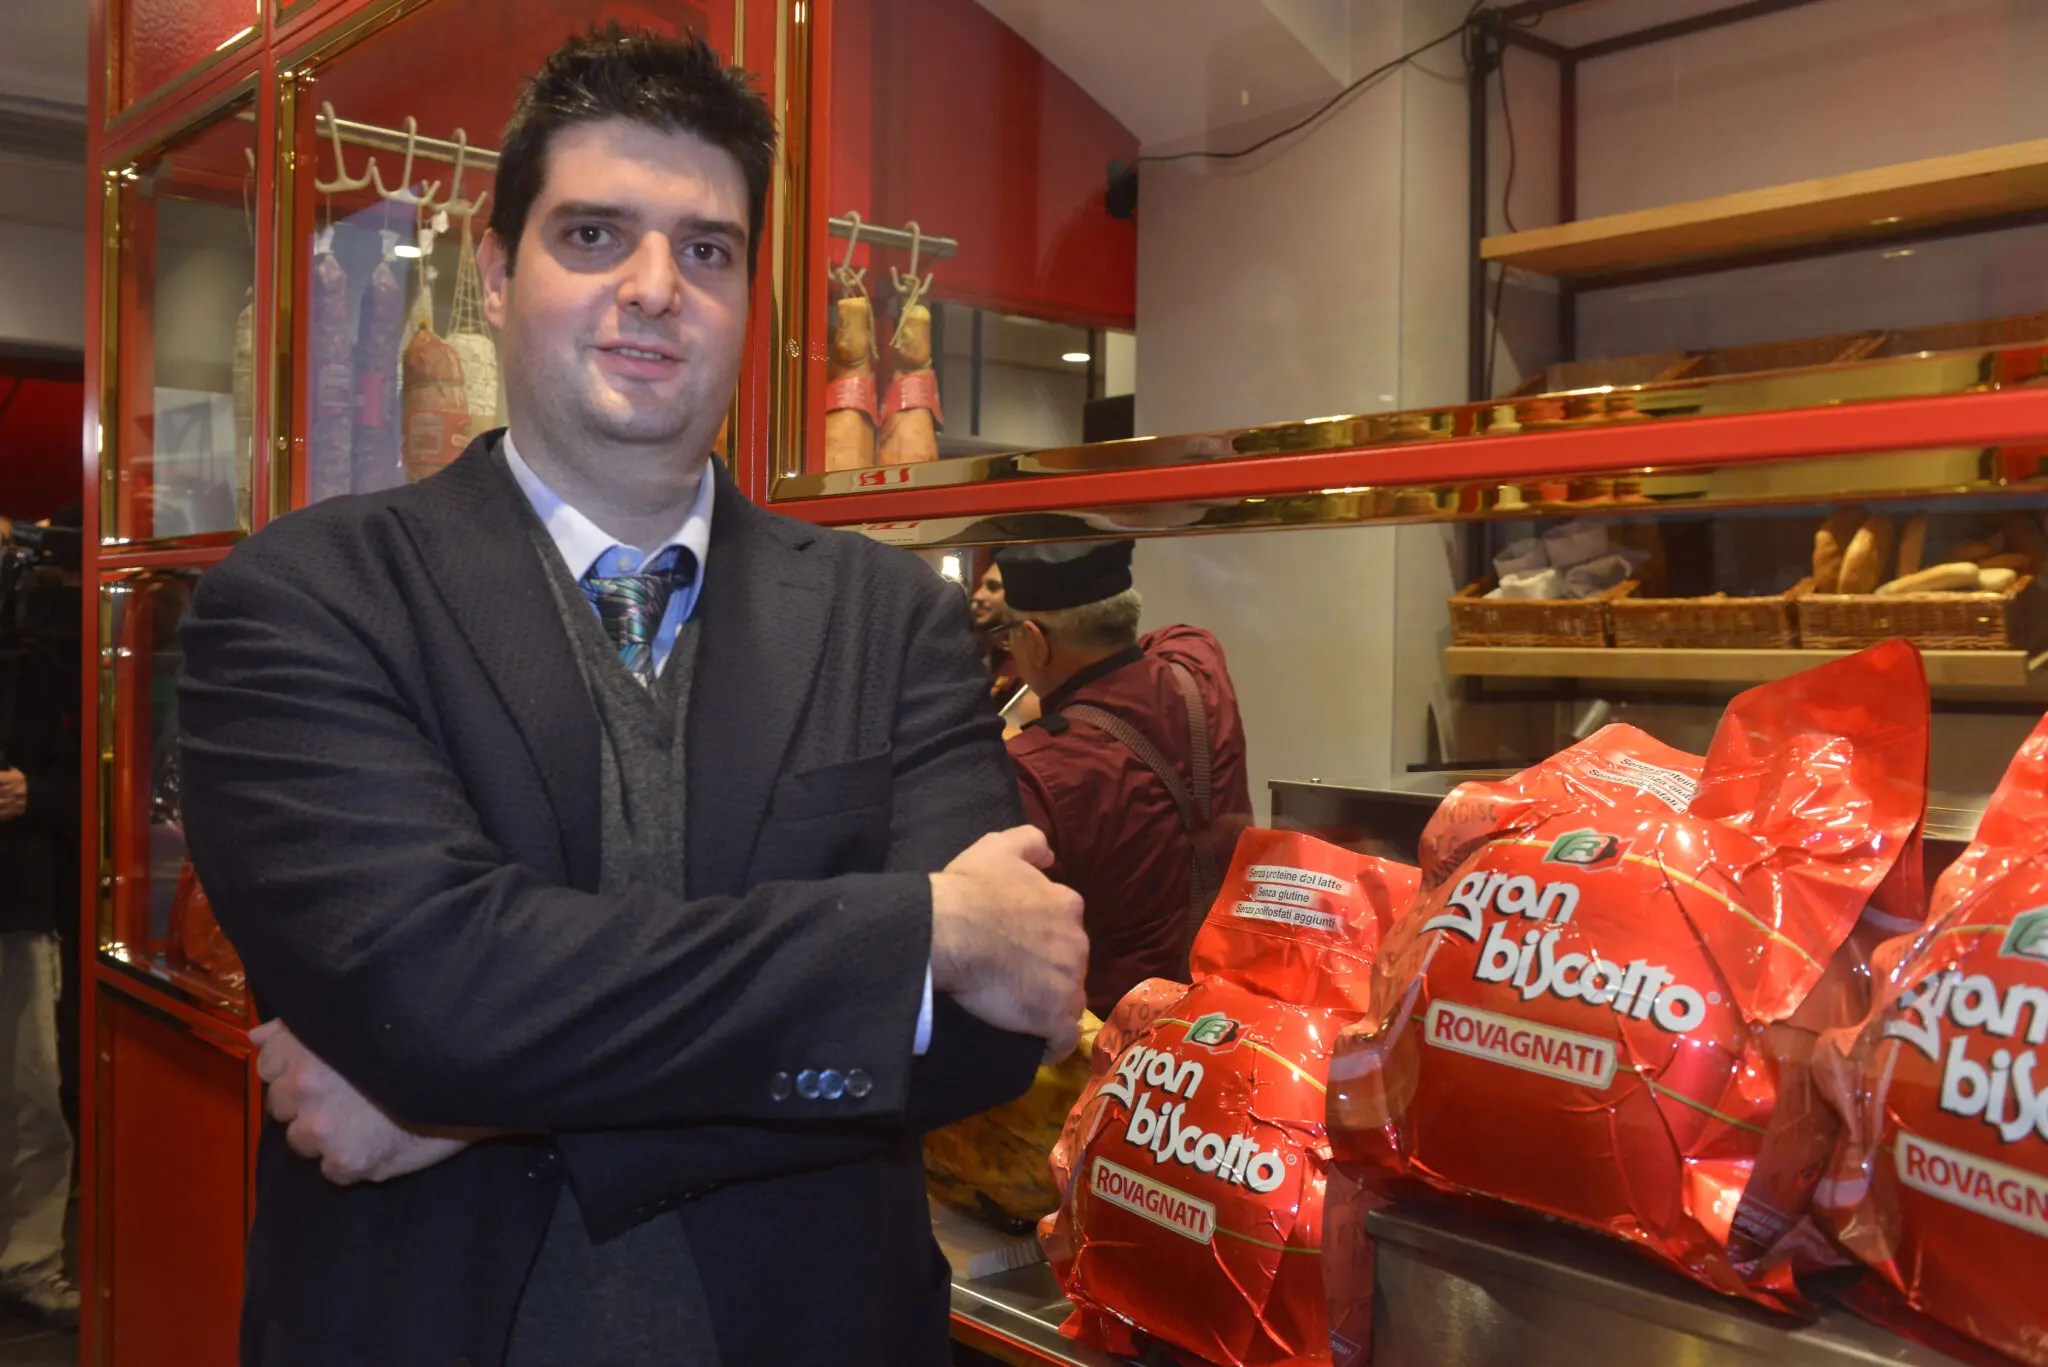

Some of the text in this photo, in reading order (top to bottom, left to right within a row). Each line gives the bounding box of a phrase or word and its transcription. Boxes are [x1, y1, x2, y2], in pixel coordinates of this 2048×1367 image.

[1249, 867, 1343, 891] Senza proteine del latte
[1257, 886, 1310, 903] Senza glutine
[1419, 871, 1580, 943] gran
[1235, 903, 1336, 928] Senza polifosfati aggiunti
[1475, 920, 1706, 1033] biscotto
[1095, 1045, 1204, 1109] gran
[1434, 1009, 1604, 1077] ROVAGNATI
[1125, 1092, 1286, 1193] biscotto
[1096, 1165, 1209, 1233] ROVAGNATI
